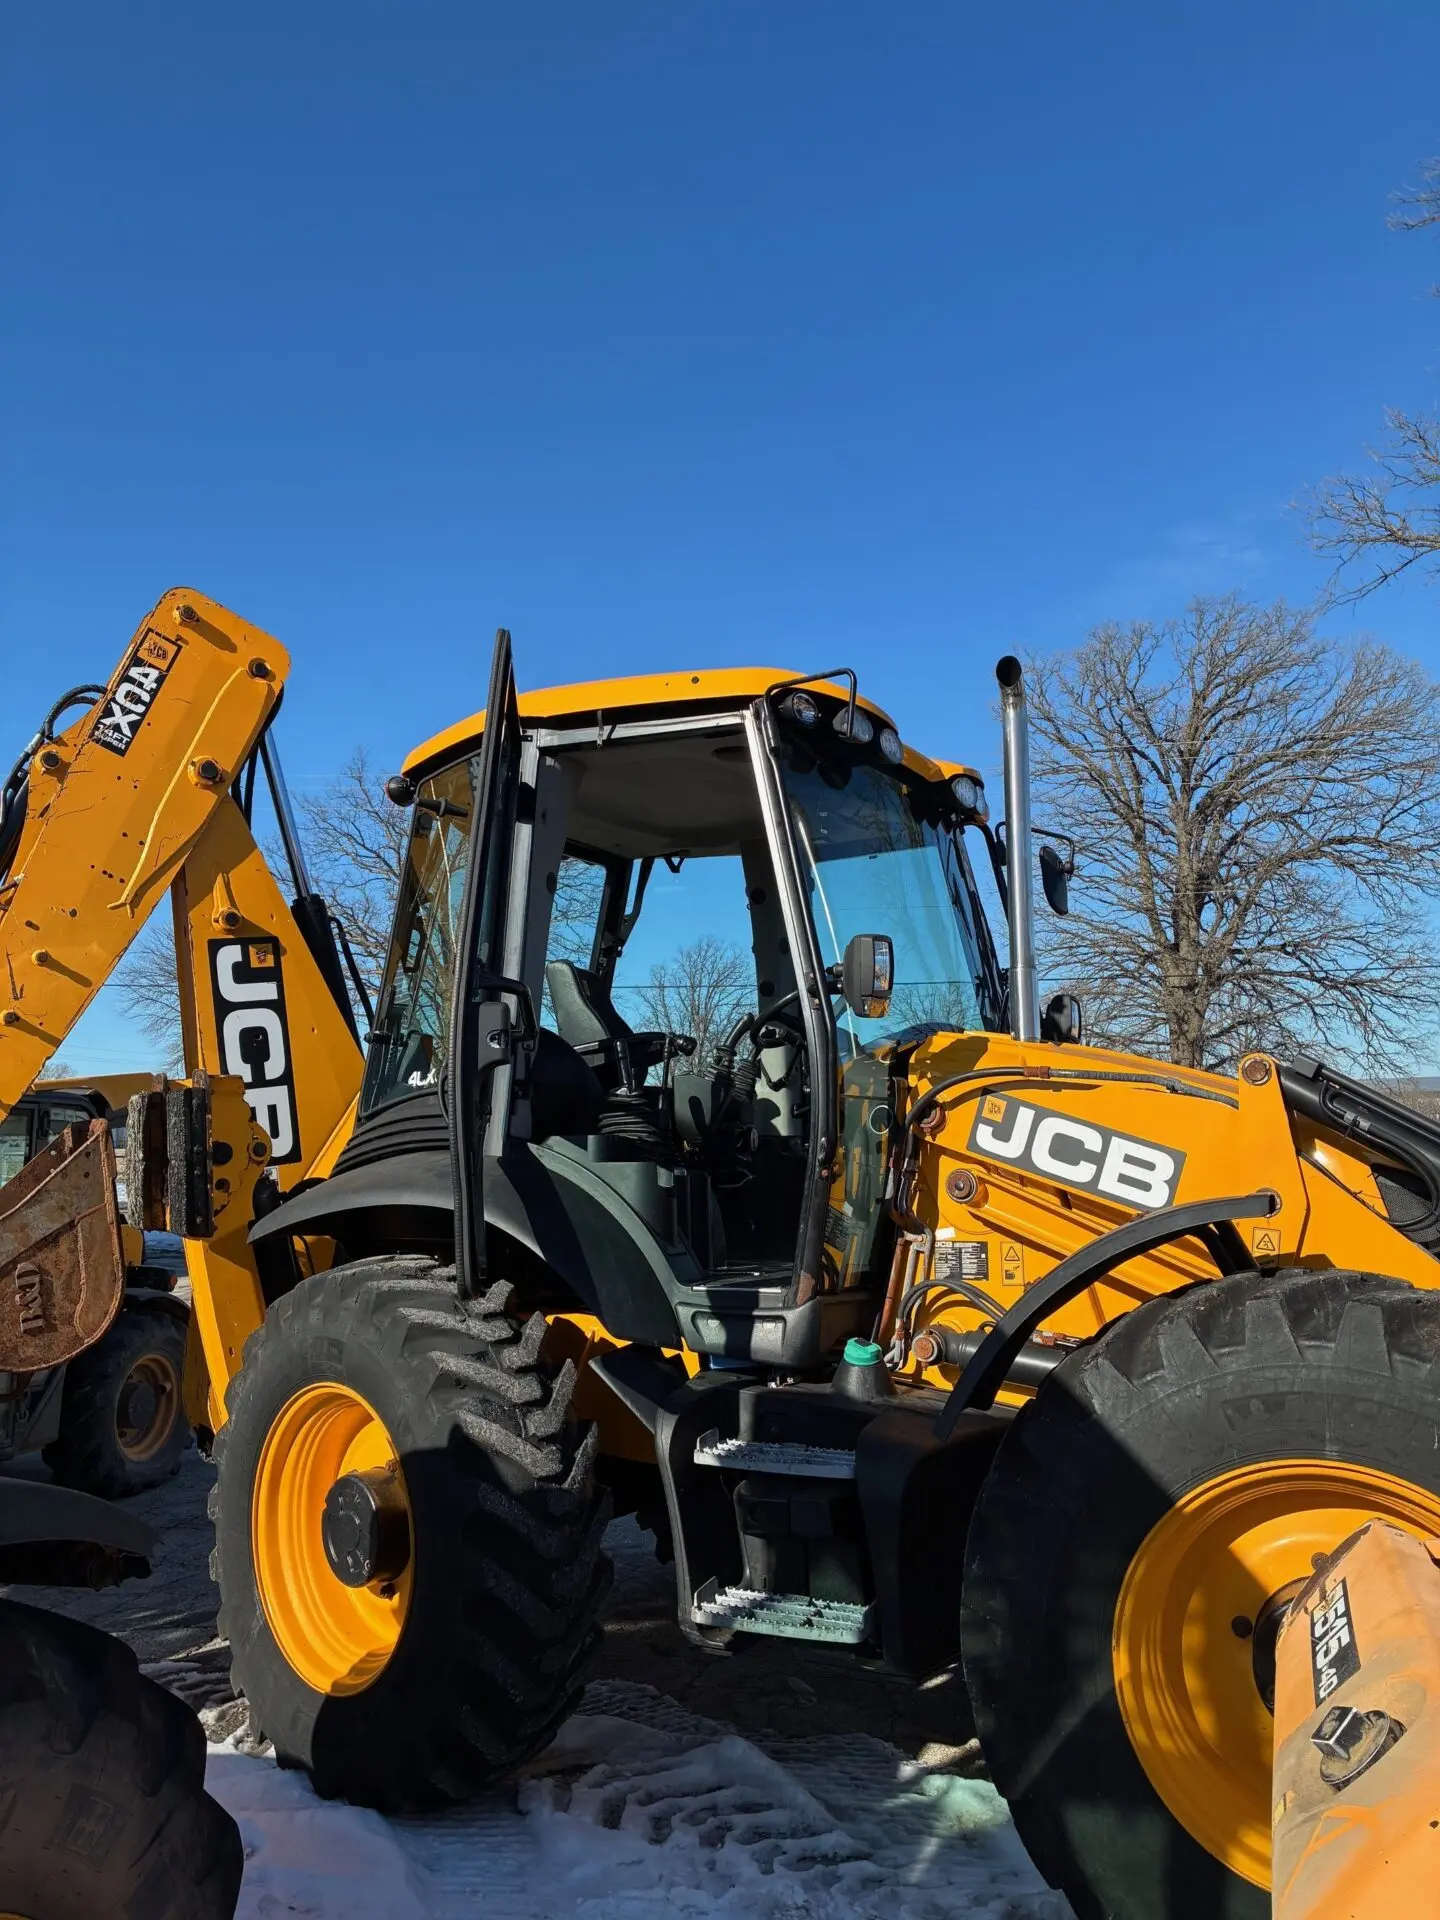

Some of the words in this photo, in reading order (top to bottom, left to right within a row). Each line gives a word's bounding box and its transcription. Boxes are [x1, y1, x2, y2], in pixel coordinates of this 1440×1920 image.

[99, 666, 160, 738] 4CX
[94, 730, 126, 750] SUPER
[97, 724, 131, 744] 14FT
[976, 1106, 1175, 1208] JCB
